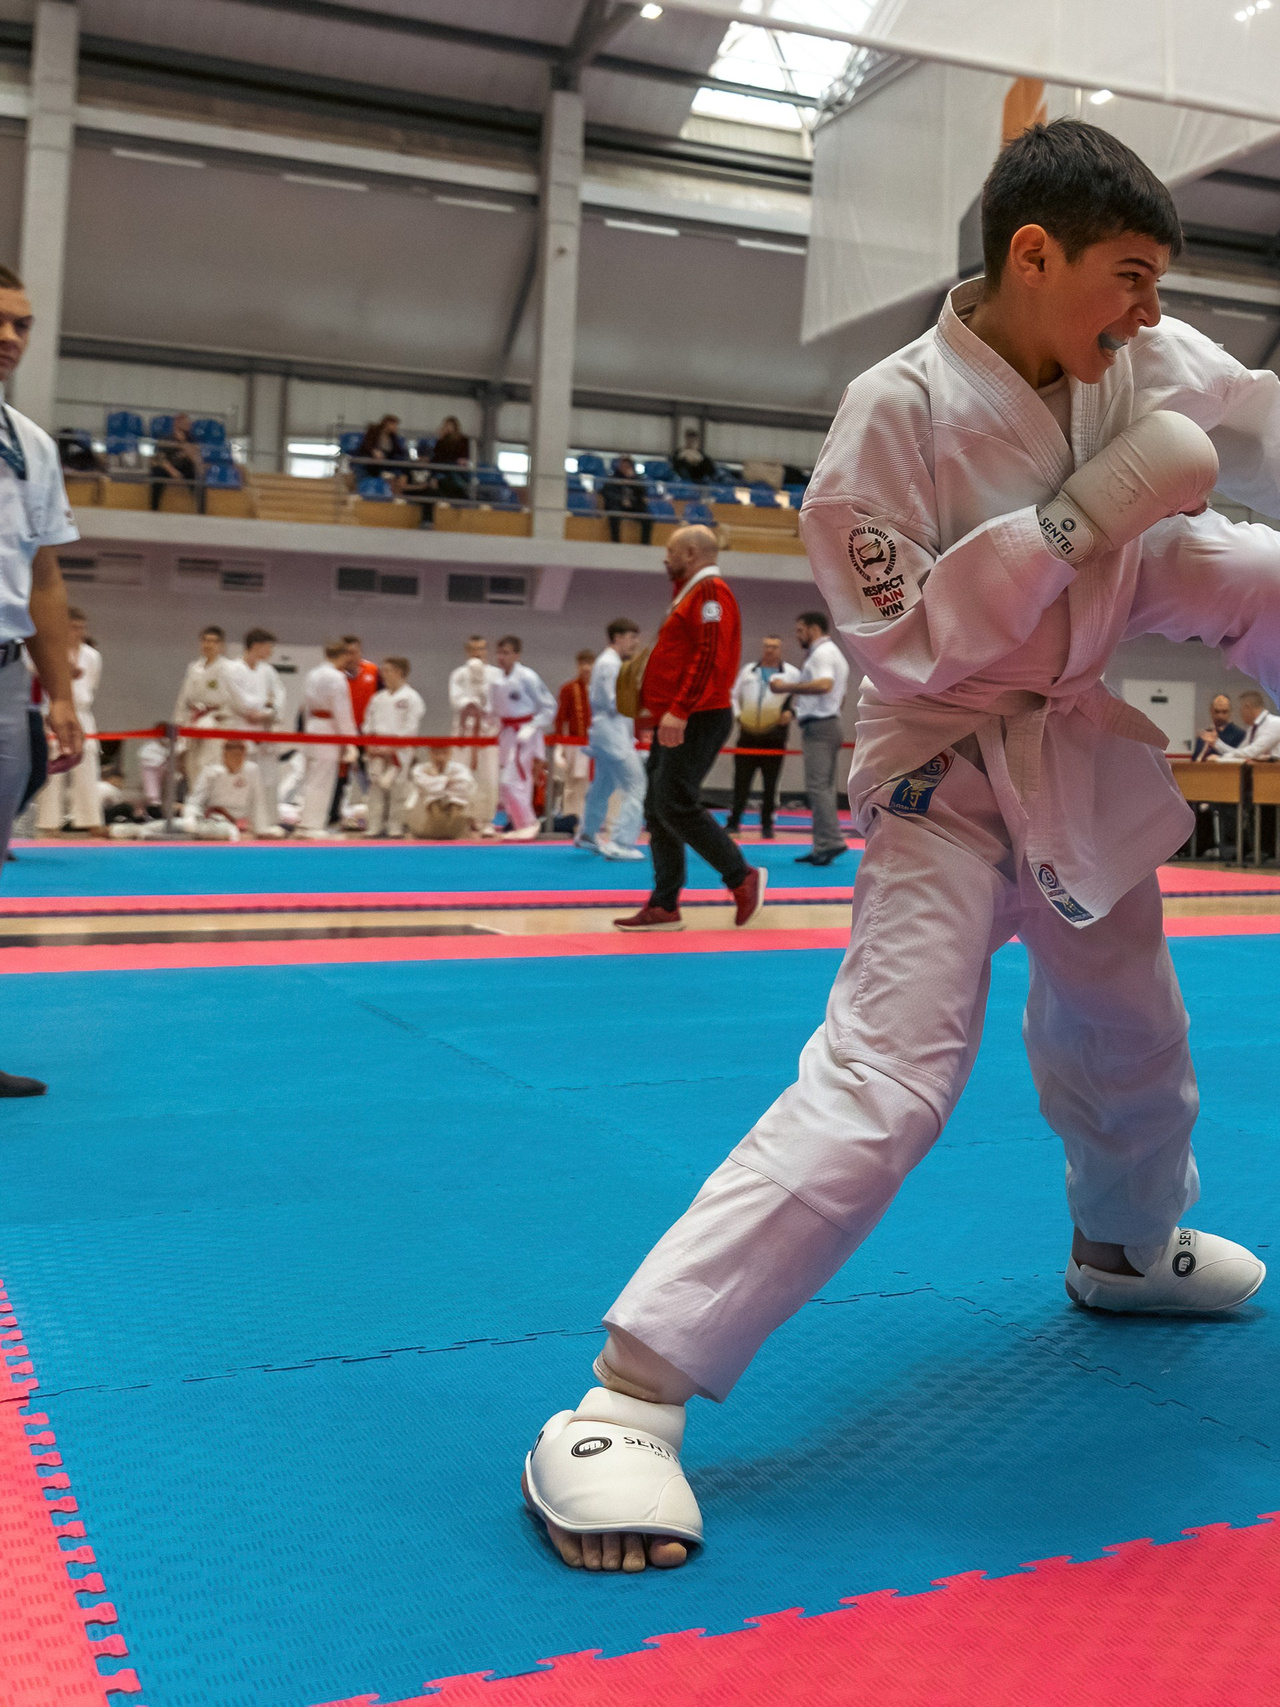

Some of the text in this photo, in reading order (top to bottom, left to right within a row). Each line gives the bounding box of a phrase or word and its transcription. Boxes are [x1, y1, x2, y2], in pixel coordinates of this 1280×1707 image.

[1039, 517, 1075, 555] SENTEI
[862, 574, 905, 597] RESPECT
[871, 587, 905, 607] TRAIN
[879, 601, 905, 617] WIN
